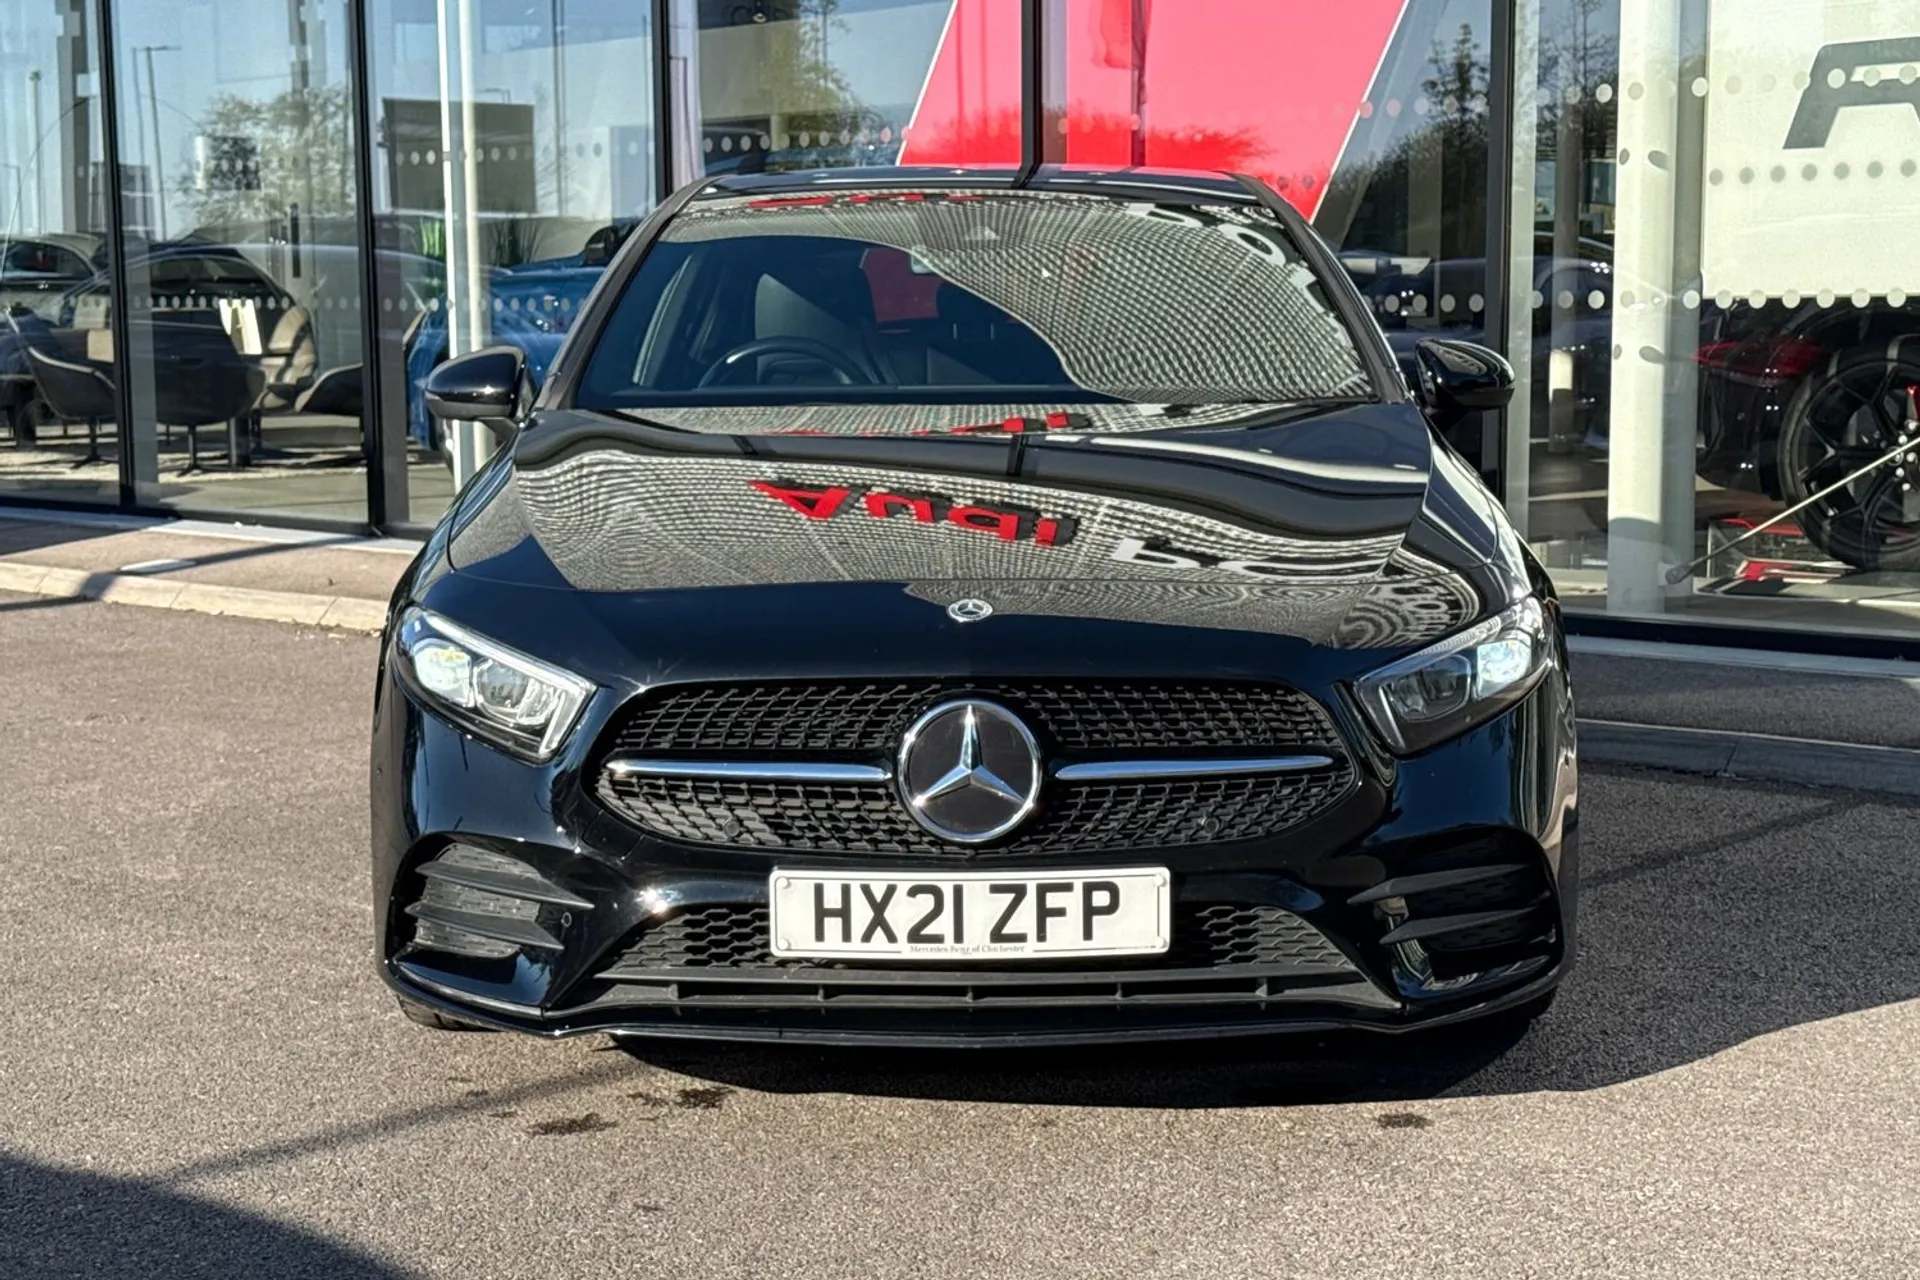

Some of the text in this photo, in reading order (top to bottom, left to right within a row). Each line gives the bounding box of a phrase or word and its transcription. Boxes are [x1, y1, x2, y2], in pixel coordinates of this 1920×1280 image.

[813, 880, 1121, 944] HX21 ZFP
[981, 944, 1025, 953] Chichester
